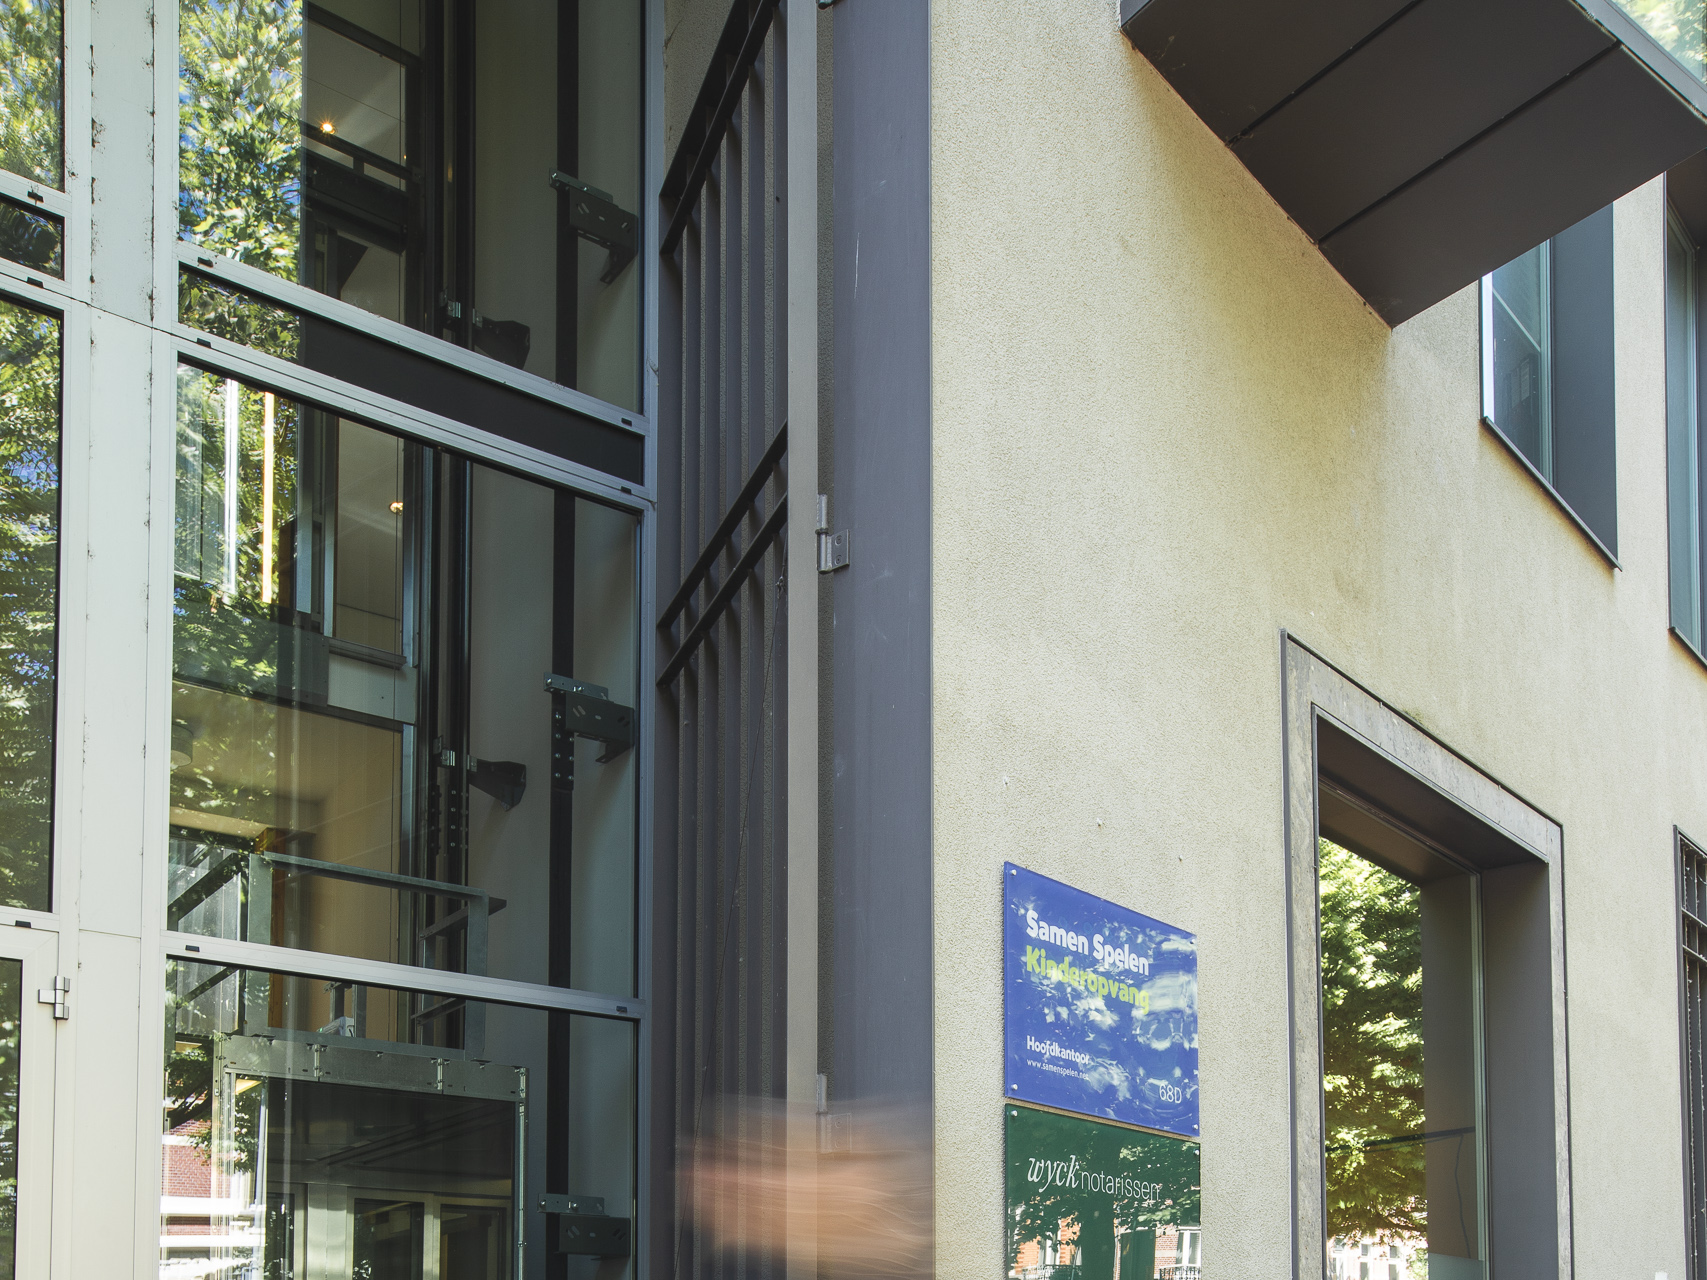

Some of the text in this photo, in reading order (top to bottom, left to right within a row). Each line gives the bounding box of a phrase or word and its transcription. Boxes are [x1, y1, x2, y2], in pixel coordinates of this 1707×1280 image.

[1026, 909, 1149, 976] Samen Spelen
[1026, 944, 1149, 1015] Kinderopvang
[1026, 1035, 1090, 1065] Hoofdkantoor
[1159, 1083, 1182, 1104] 68D
